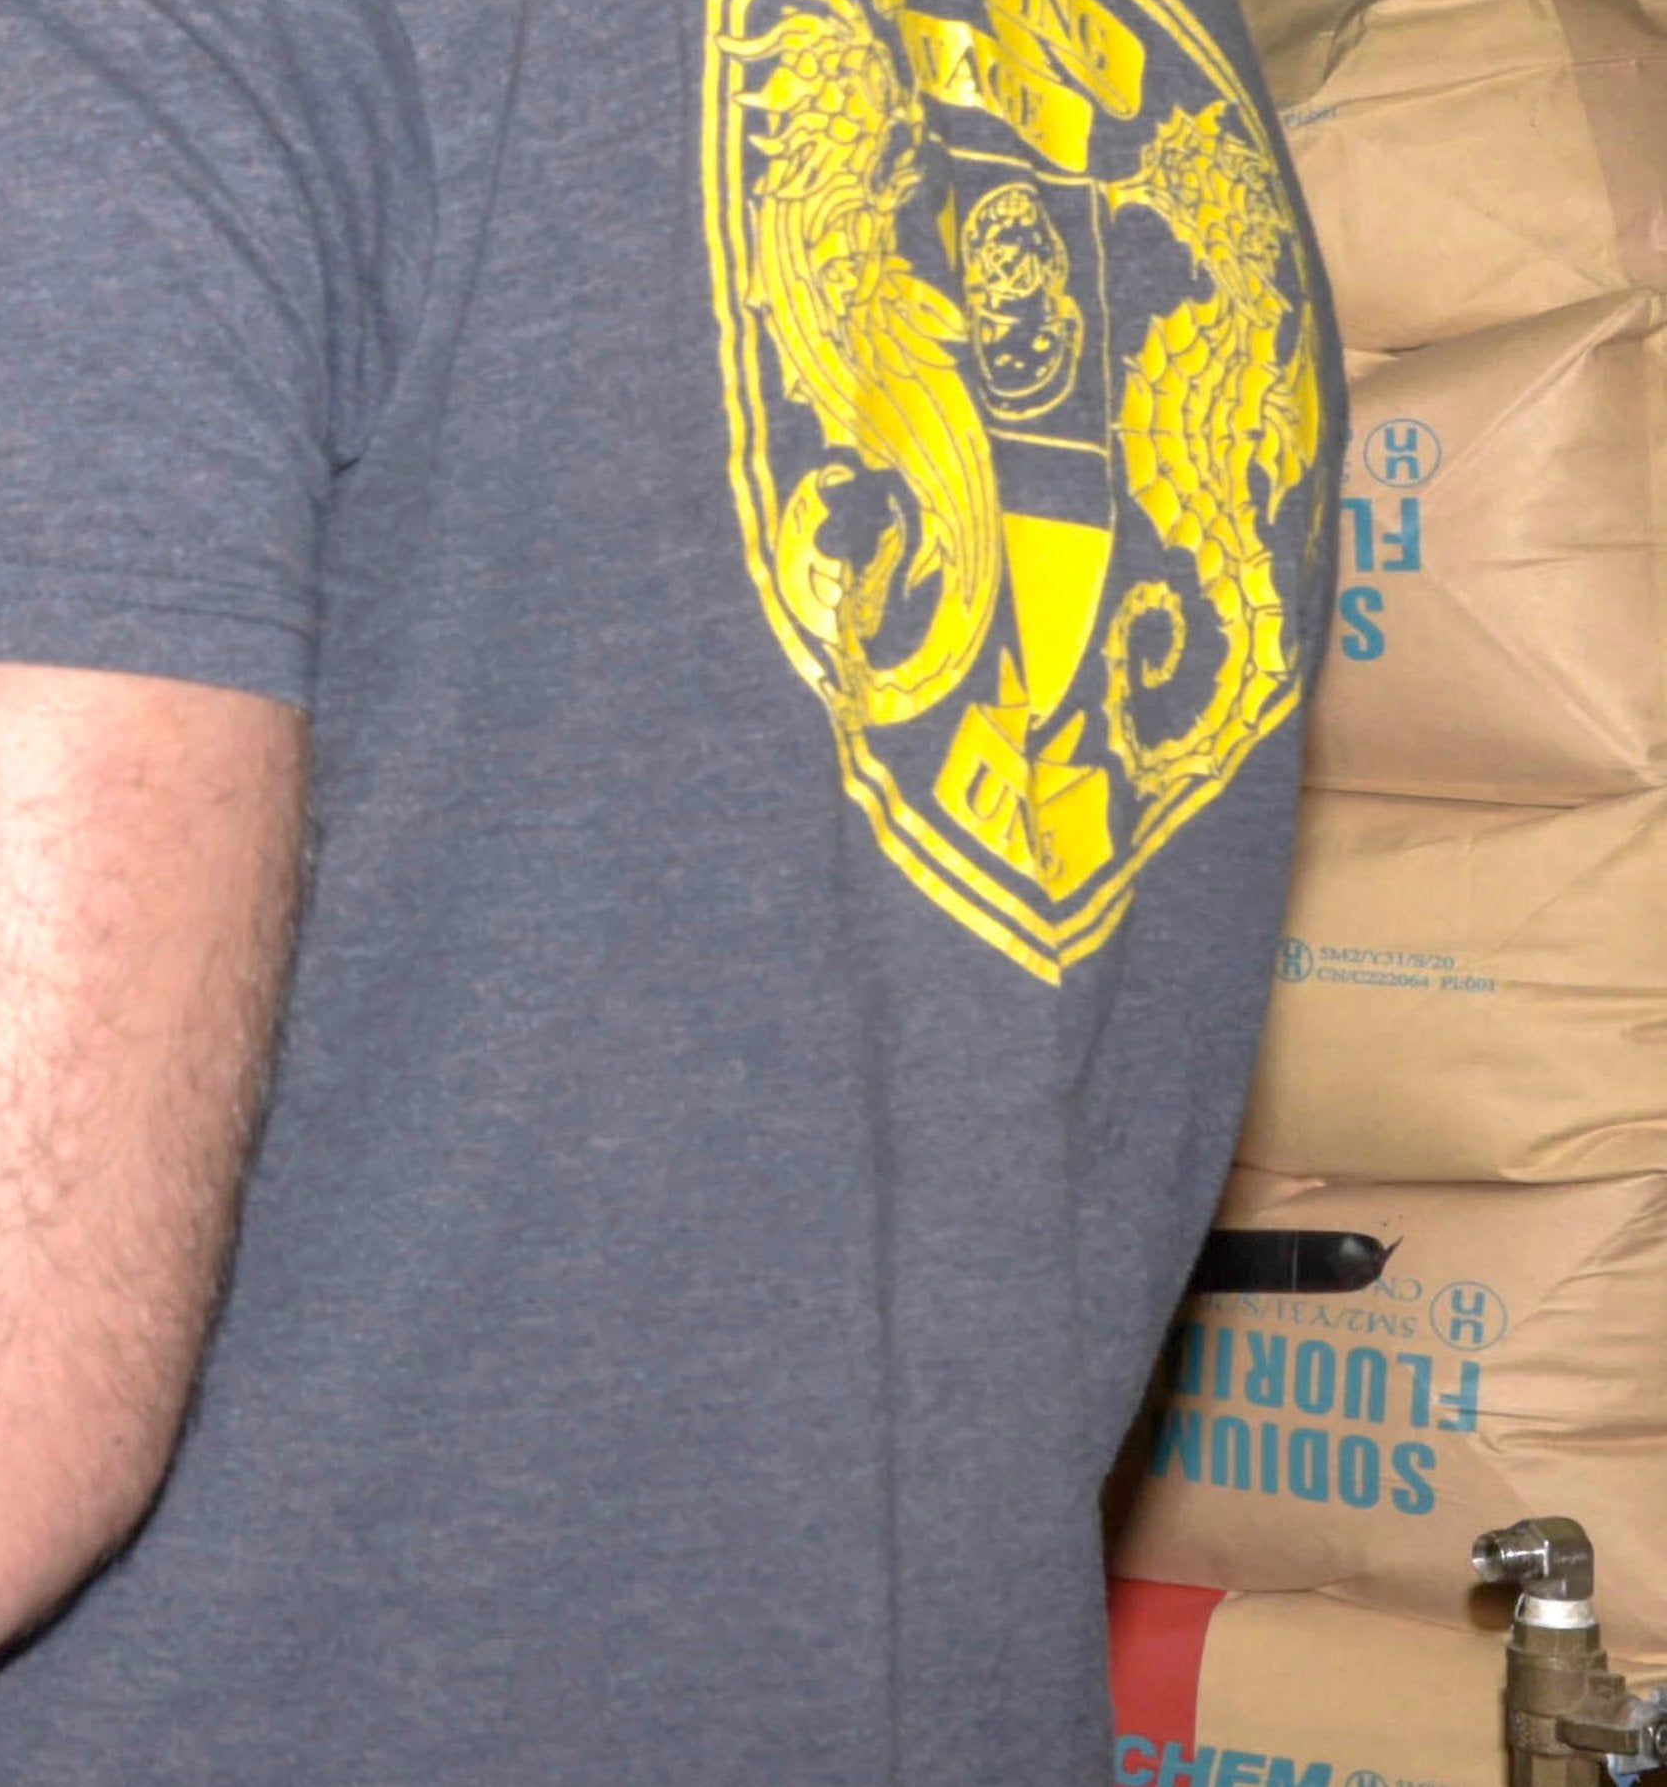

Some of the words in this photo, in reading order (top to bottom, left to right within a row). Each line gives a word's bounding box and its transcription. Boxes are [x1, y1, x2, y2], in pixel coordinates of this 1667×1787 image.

[1341, 497, 1421, 571] FL
[1340, 586, 1386, 661] S
[1154, 1408, 1436, 1516] SODIUM
